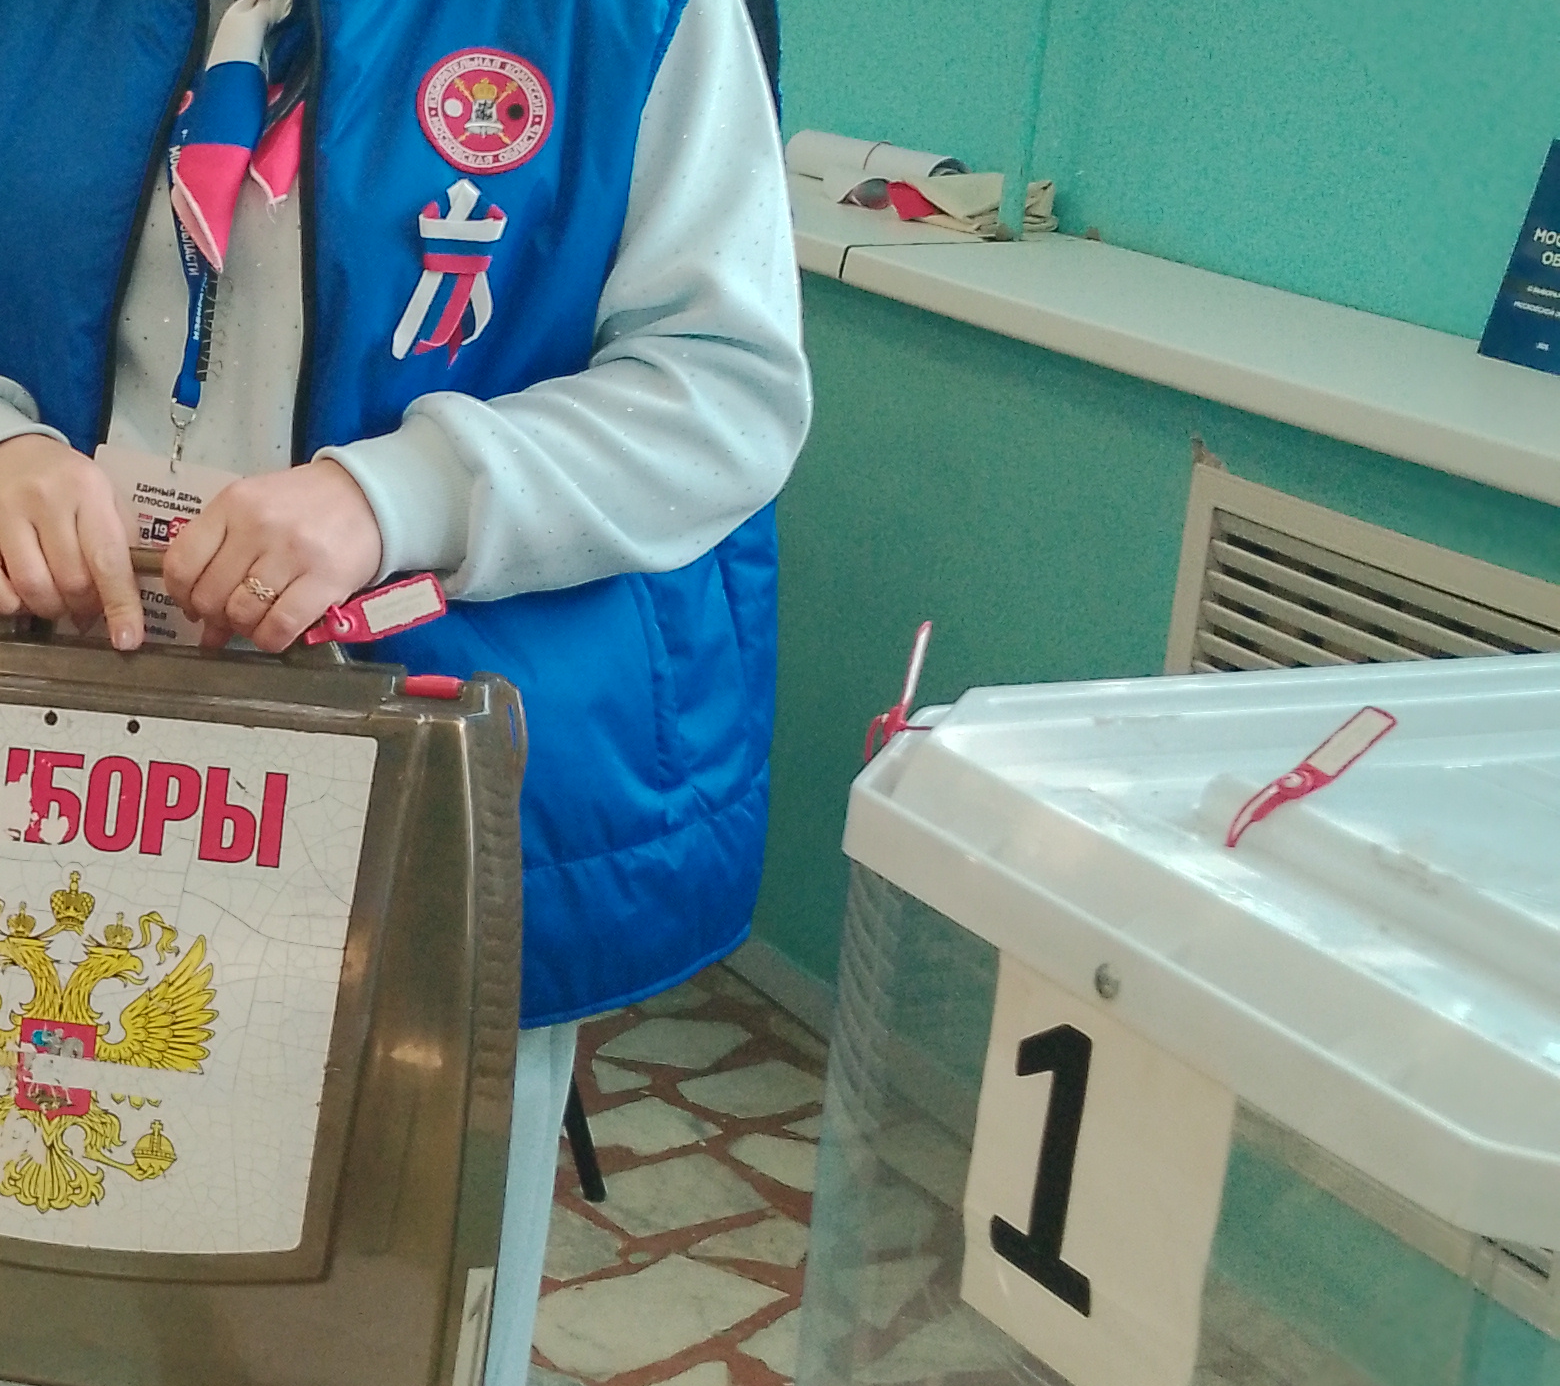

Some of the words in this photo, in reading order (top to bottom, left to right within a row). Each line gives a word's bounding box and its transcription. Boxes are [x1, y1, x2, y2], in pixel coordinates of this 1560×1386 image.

[136, 482, 176, 498] ЕДИНЫЙ
[176, 491, 202, 504] ДЕНЬ
[132, 494, 201, 515] ГОЛОСОВАНИЯ
[154, 523, 168, 537] 19
[990, 1023, 1093, 1318] 1
